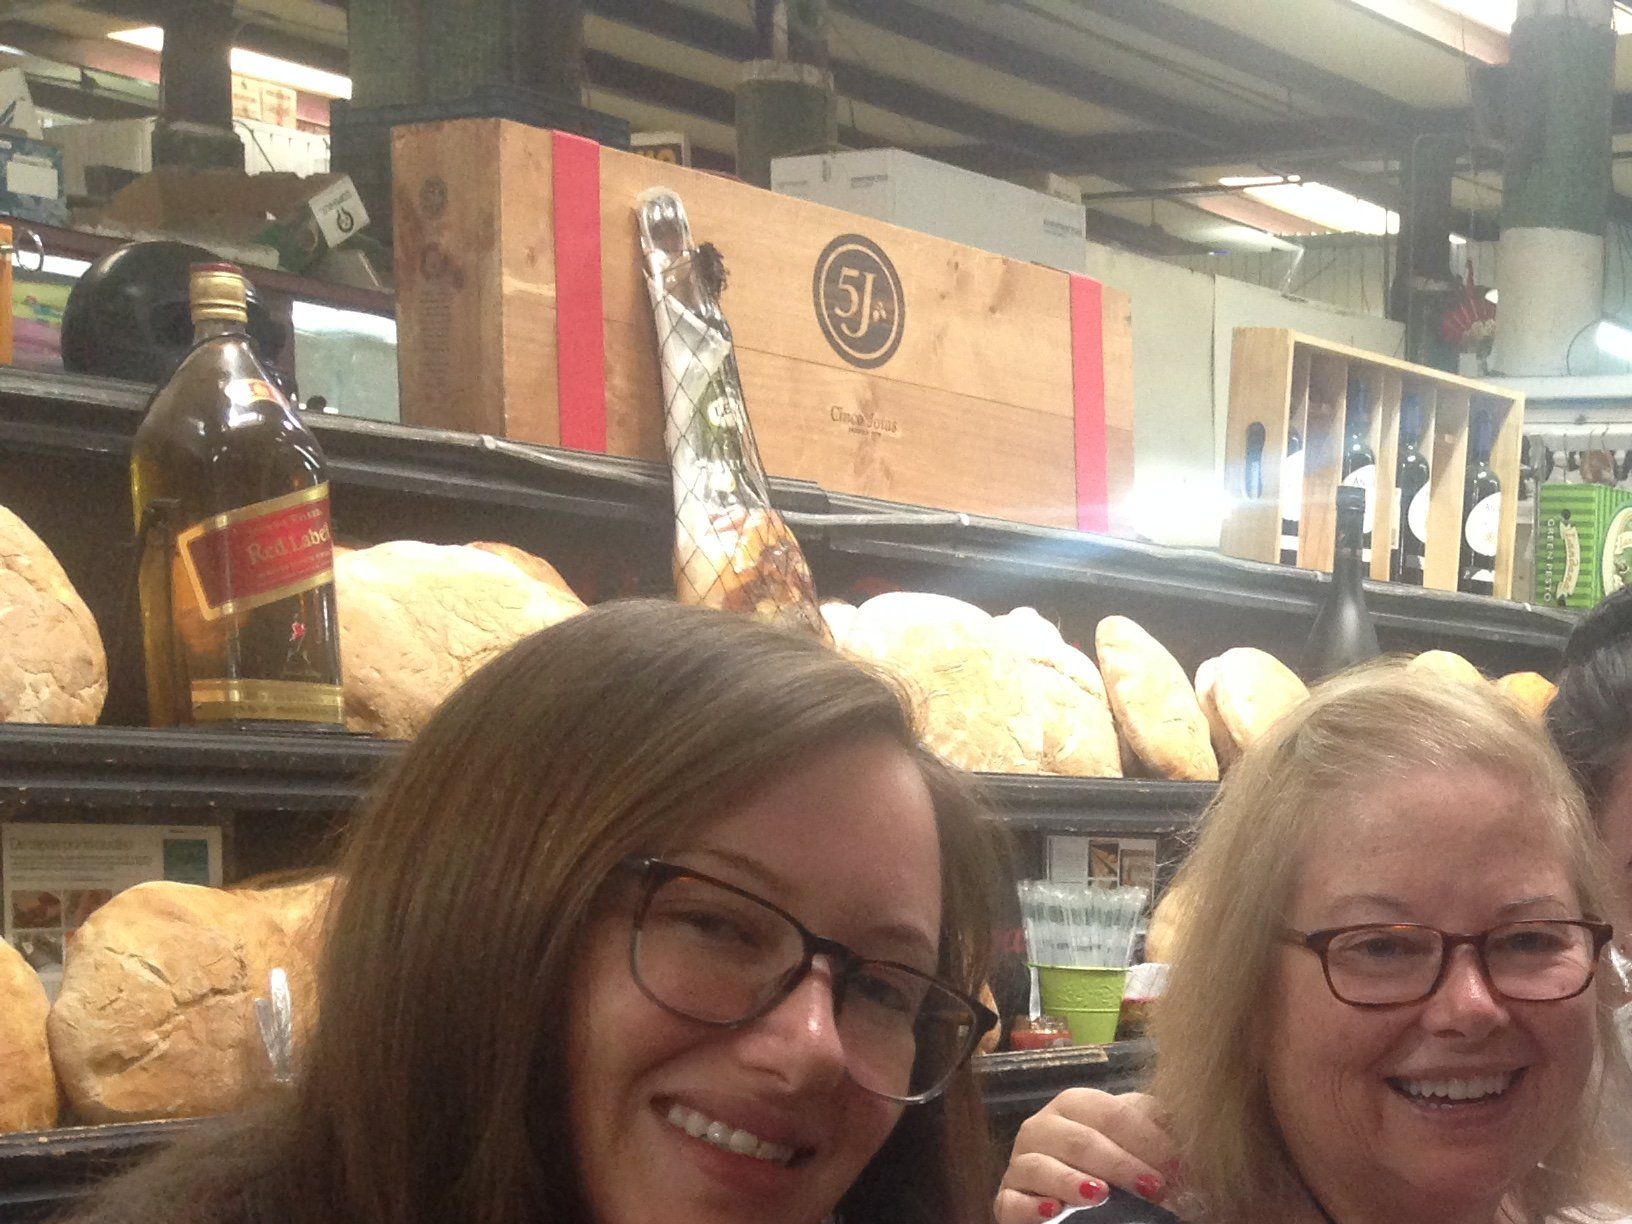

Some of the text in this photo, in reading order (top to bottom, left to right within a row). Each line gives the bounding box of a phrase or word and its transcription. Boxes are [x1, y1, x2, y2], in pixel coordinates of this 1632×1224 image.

[834, 266, 877, 338] 5J
[248, 540, 285, 565] Red
[1543, 518, 1555, 602] GREEN PESTO
